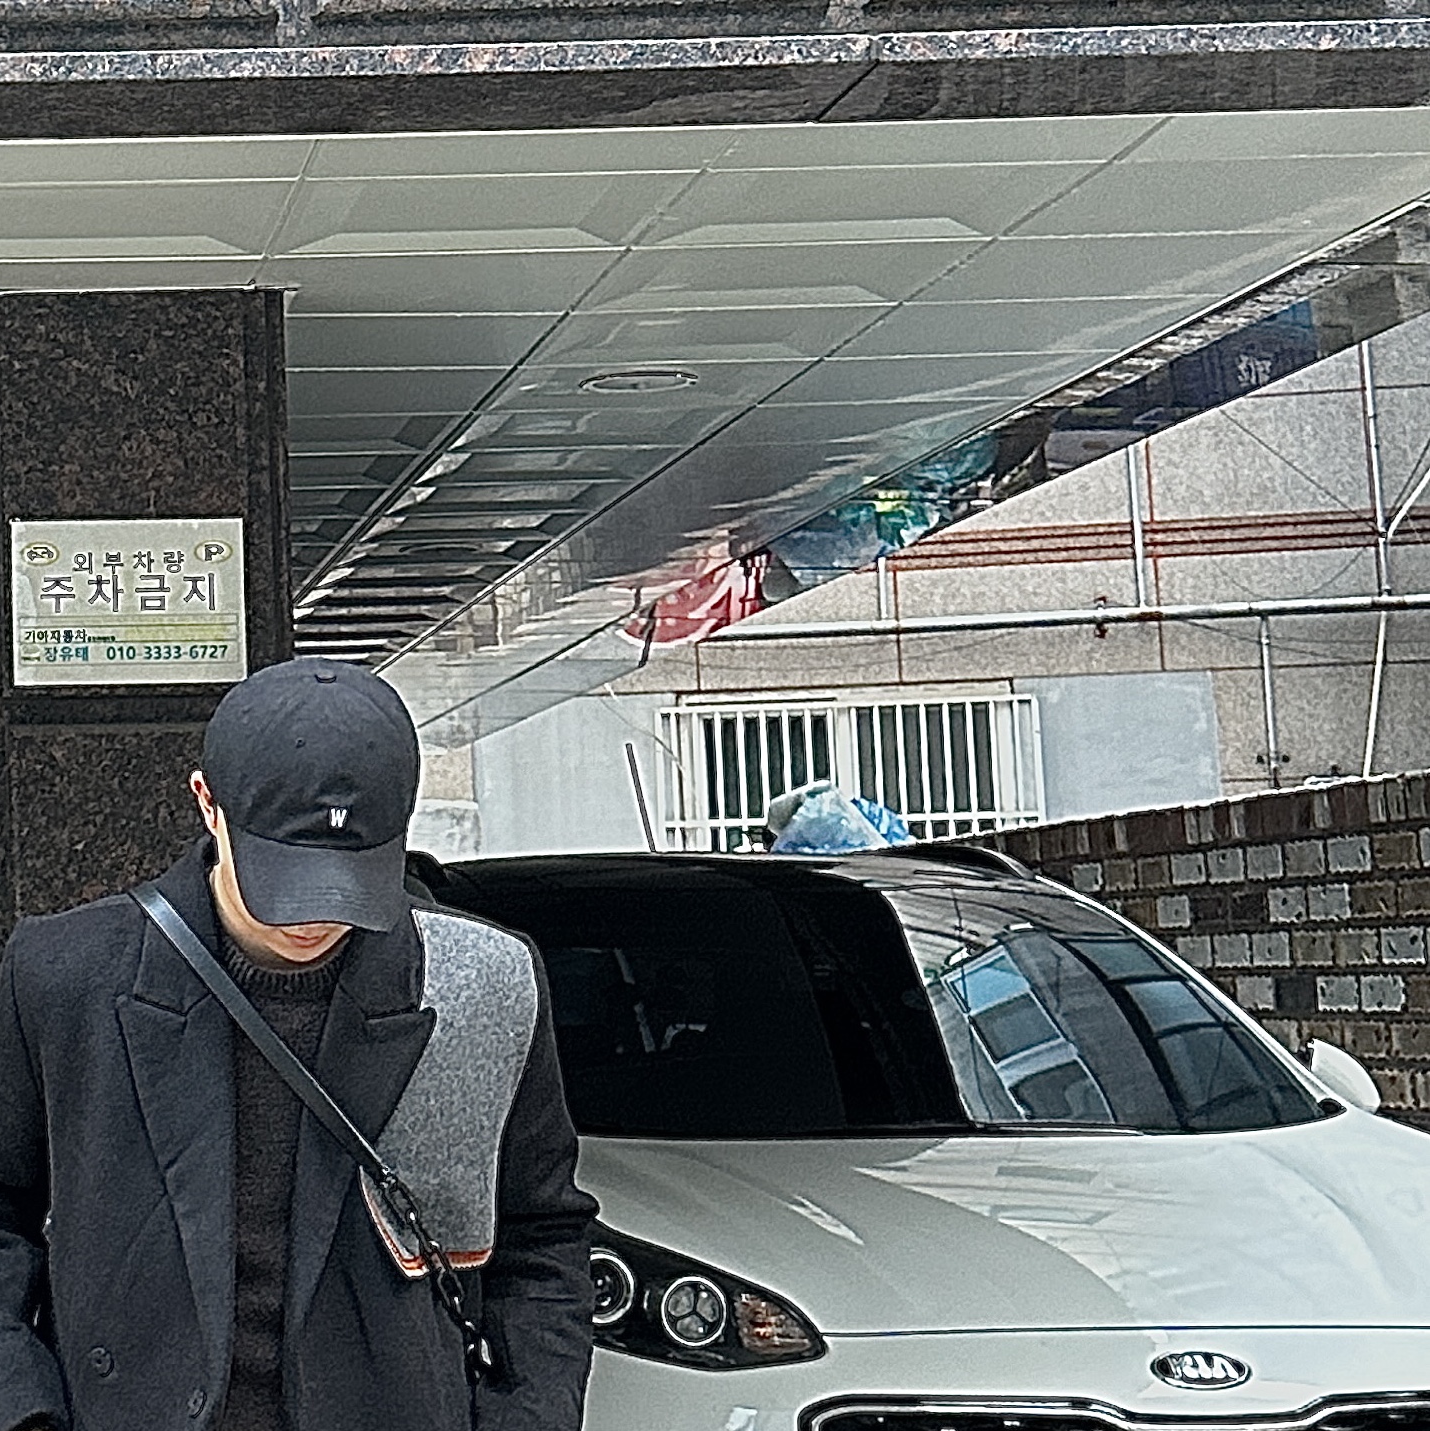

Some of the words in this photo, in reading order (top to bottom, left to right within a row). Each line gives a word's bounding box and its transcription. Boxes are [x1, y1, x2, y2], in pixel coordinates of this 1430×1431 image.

[72, 551, 185, 574] 외부차량
[204, 544, 225, 562] P
[39, 573, 216, 613] 주차금지
[24, 629, 87, 643] 기아자동차
[43, 646, 89, 662] 장유태
[330, 807, 348, 828] W
[1166, 1352, 1242, 1381] KIA
